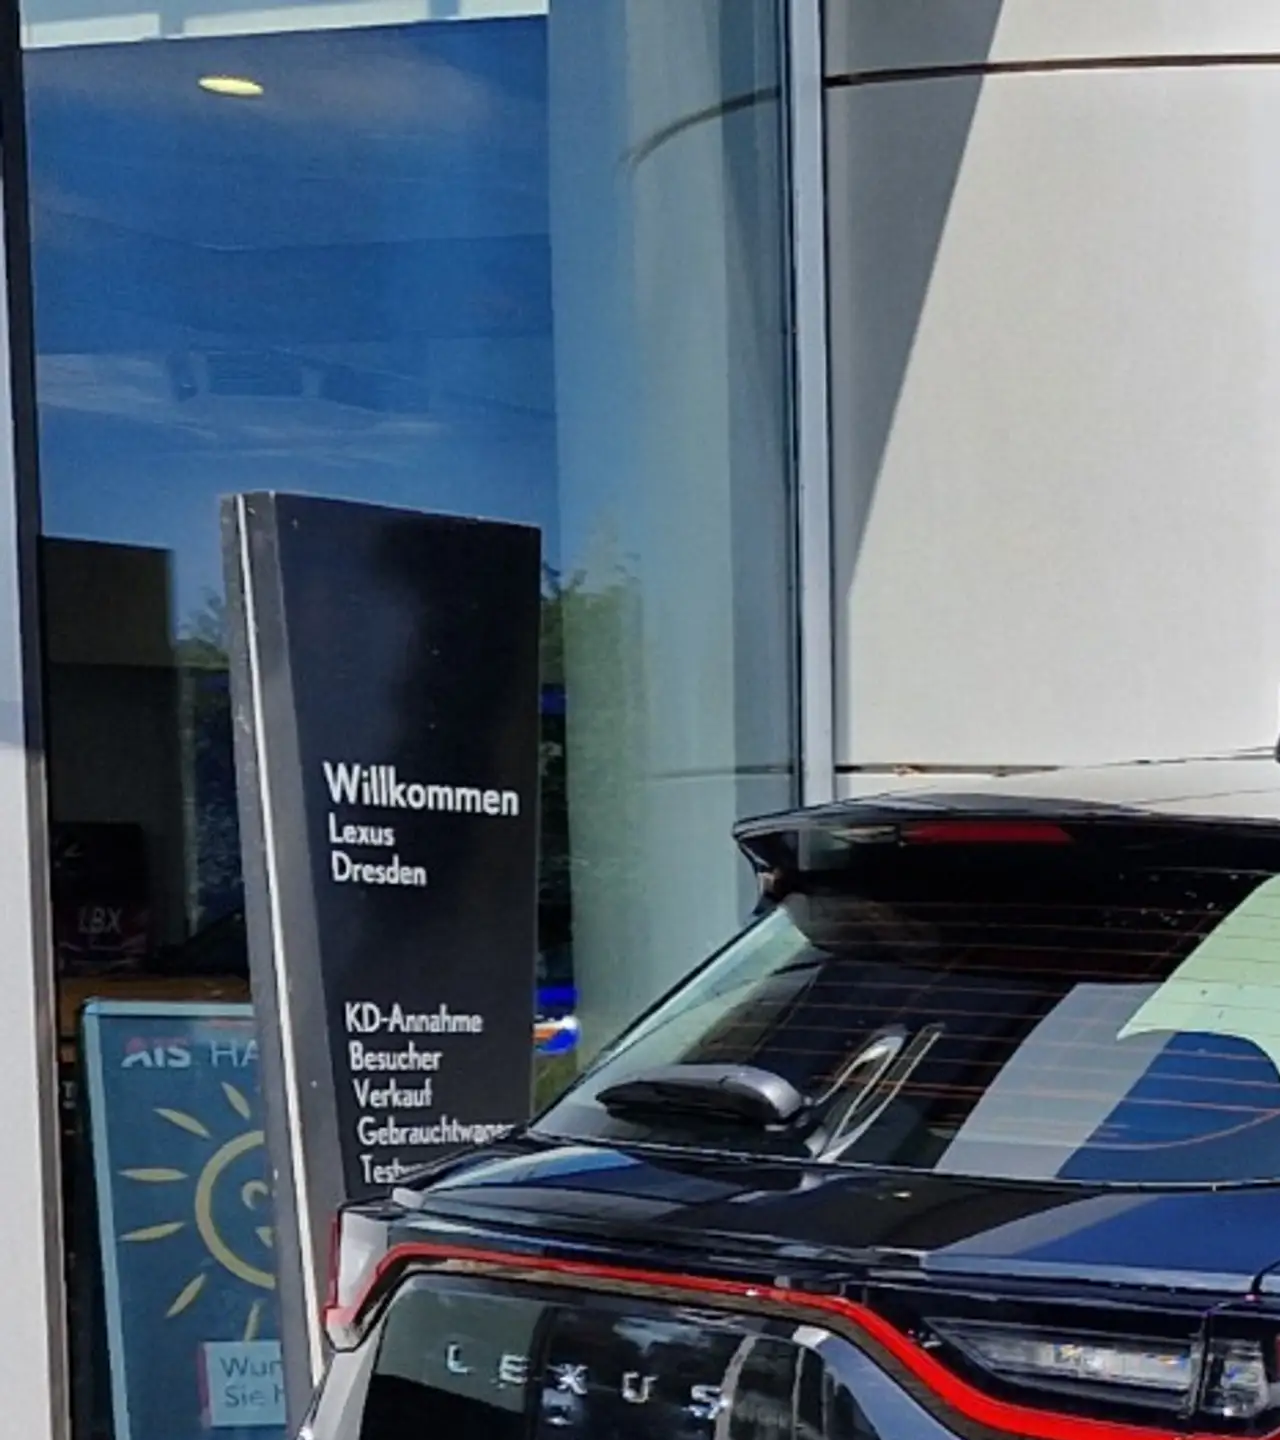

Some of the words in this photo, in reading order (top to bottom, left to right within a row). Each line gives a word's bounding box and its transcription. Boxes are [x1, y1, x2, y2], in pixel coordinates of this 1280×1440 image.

[323, 761, 519, 816] Willkommen
[328, 812, 396, 847] Lexus
[331, 850, 428, 887] Dresden
[345, 1002, 484, 1033] KD-Annahme
[349, 1040, 443, 1071] Besucher
[353, 1078, 432, 1108] Verkauf
[446, 1342, 730, 1420] LEXUS
